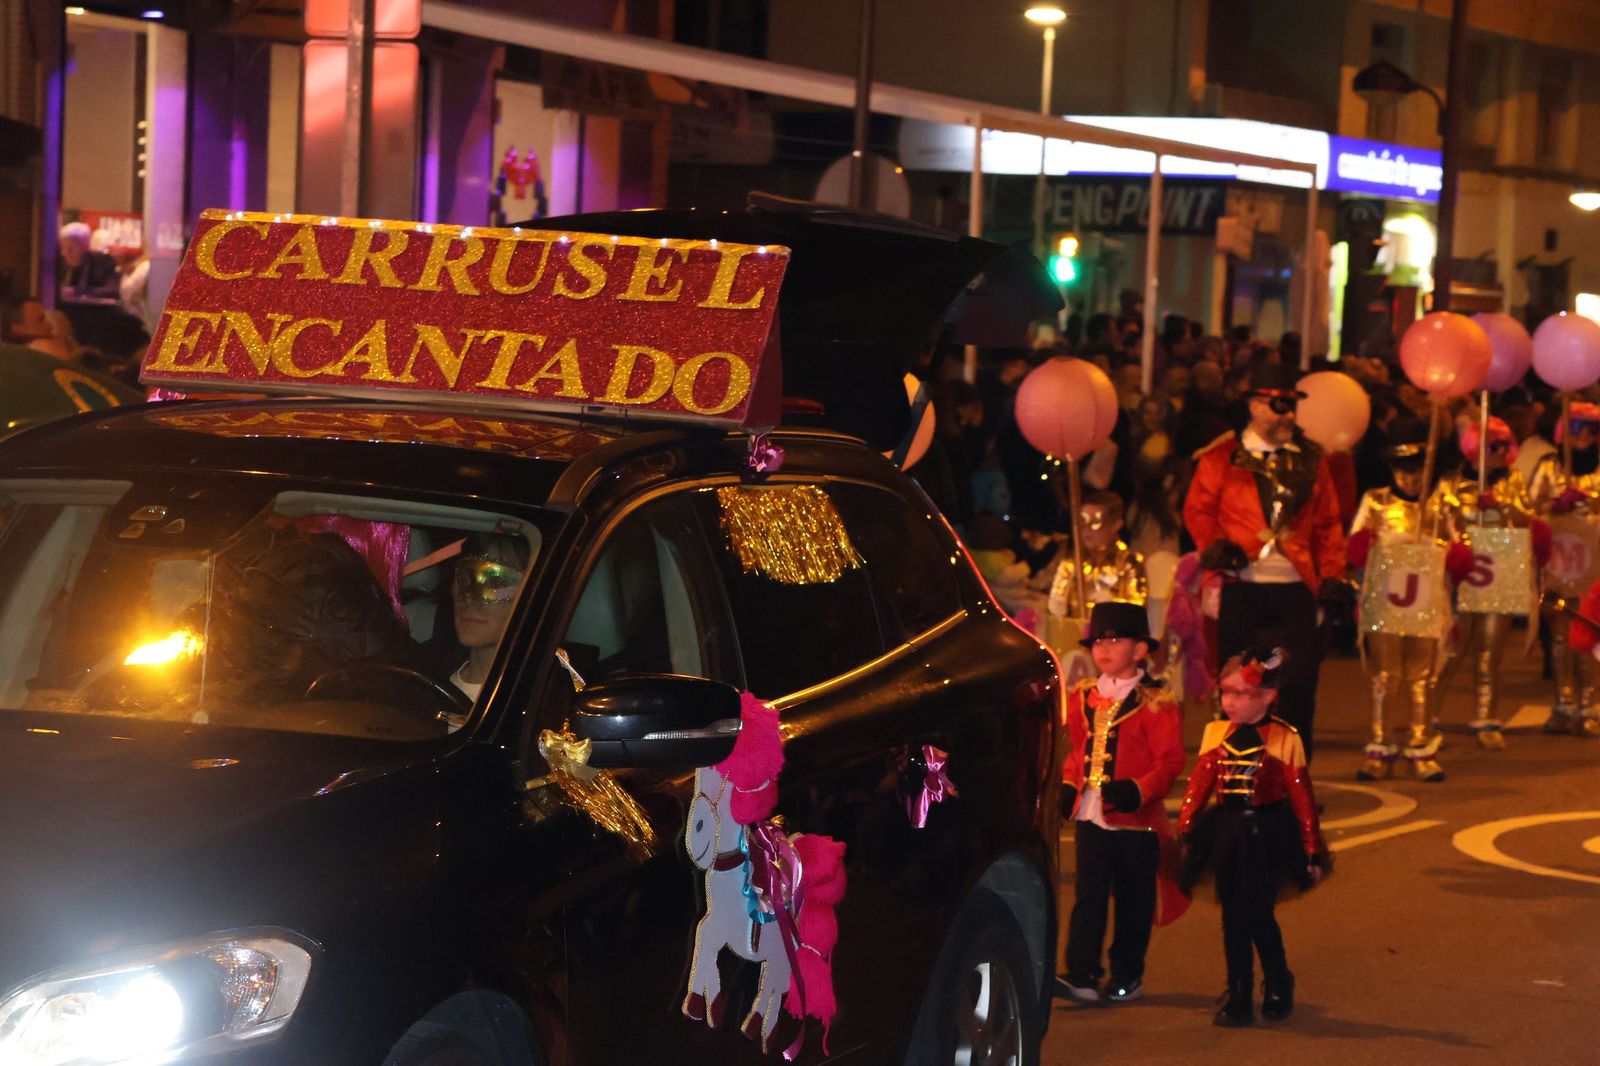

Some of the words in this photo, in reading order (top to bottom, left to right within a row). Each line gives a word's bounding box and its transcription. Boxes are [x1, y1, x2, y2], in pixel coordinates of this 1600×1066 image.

[197, 221, 766, 311] CARRUSEL
[147, 310, 753, 415] ENCANTADO
[1465, 555, 1495, 588] S
[1553, 541, 1586, 568] M
[1387, 573, 1419, 608] J
